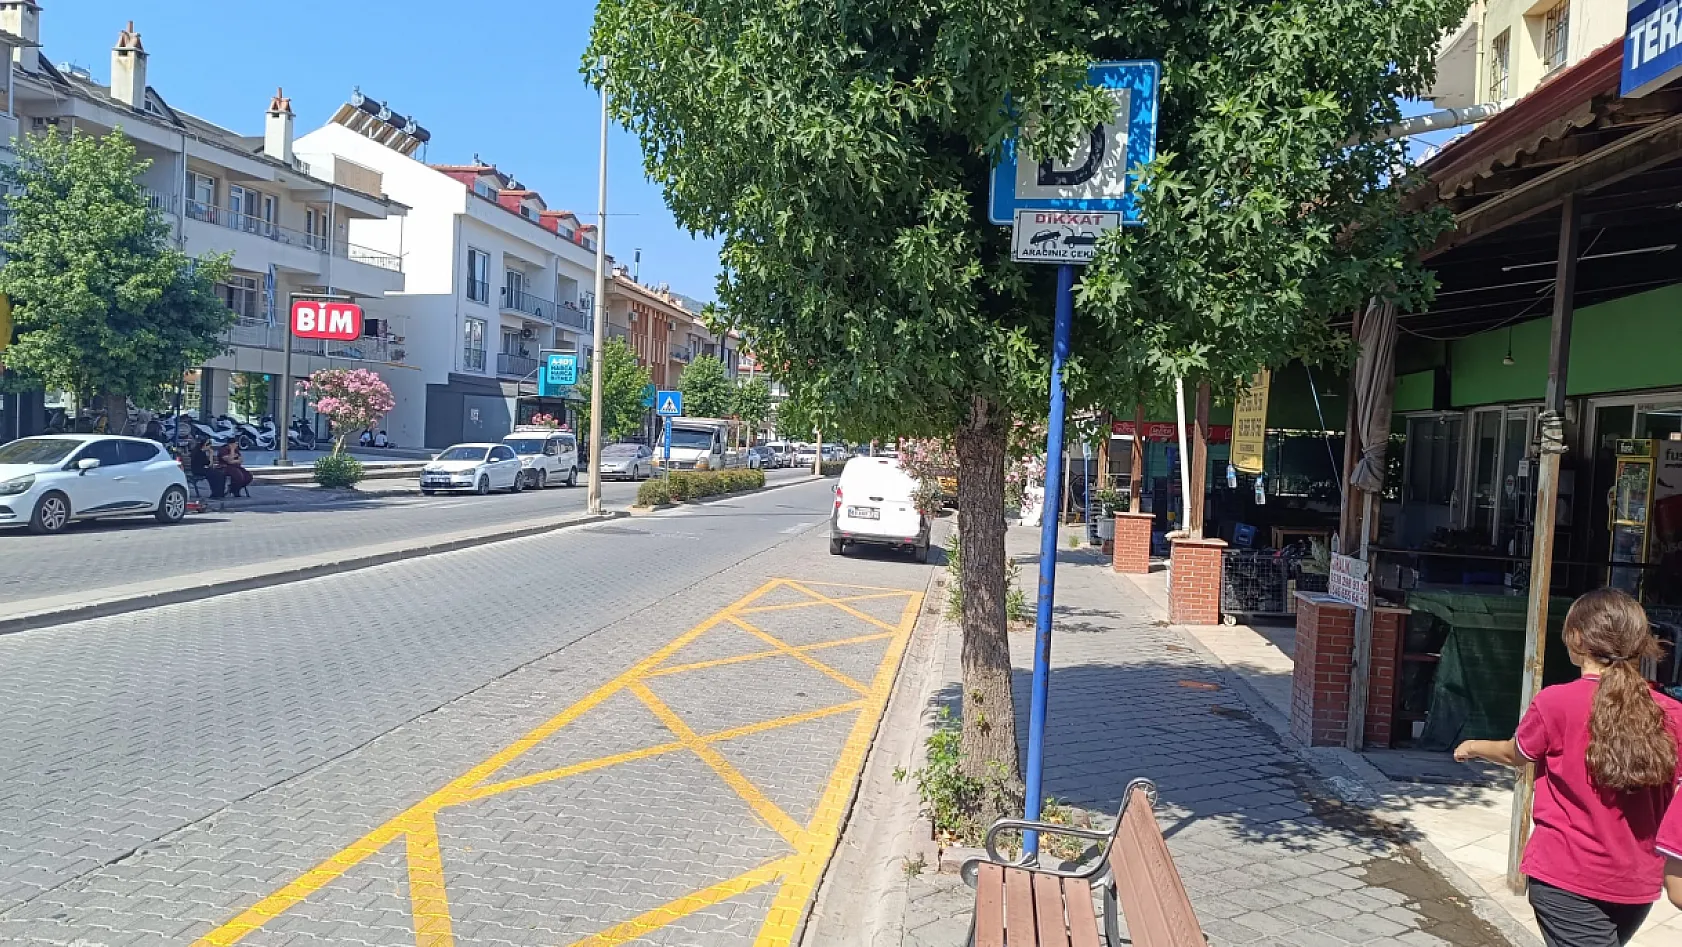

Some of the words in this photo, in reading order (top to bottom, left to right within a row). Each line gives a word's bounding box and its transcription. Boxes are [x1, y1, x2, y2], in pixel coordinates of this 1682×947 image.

[1035, 213, 1104, 226] DİKKAT
[1022, 249, 1067, 258] ARACINIZ
[297, 302, 354, 335] BİM
